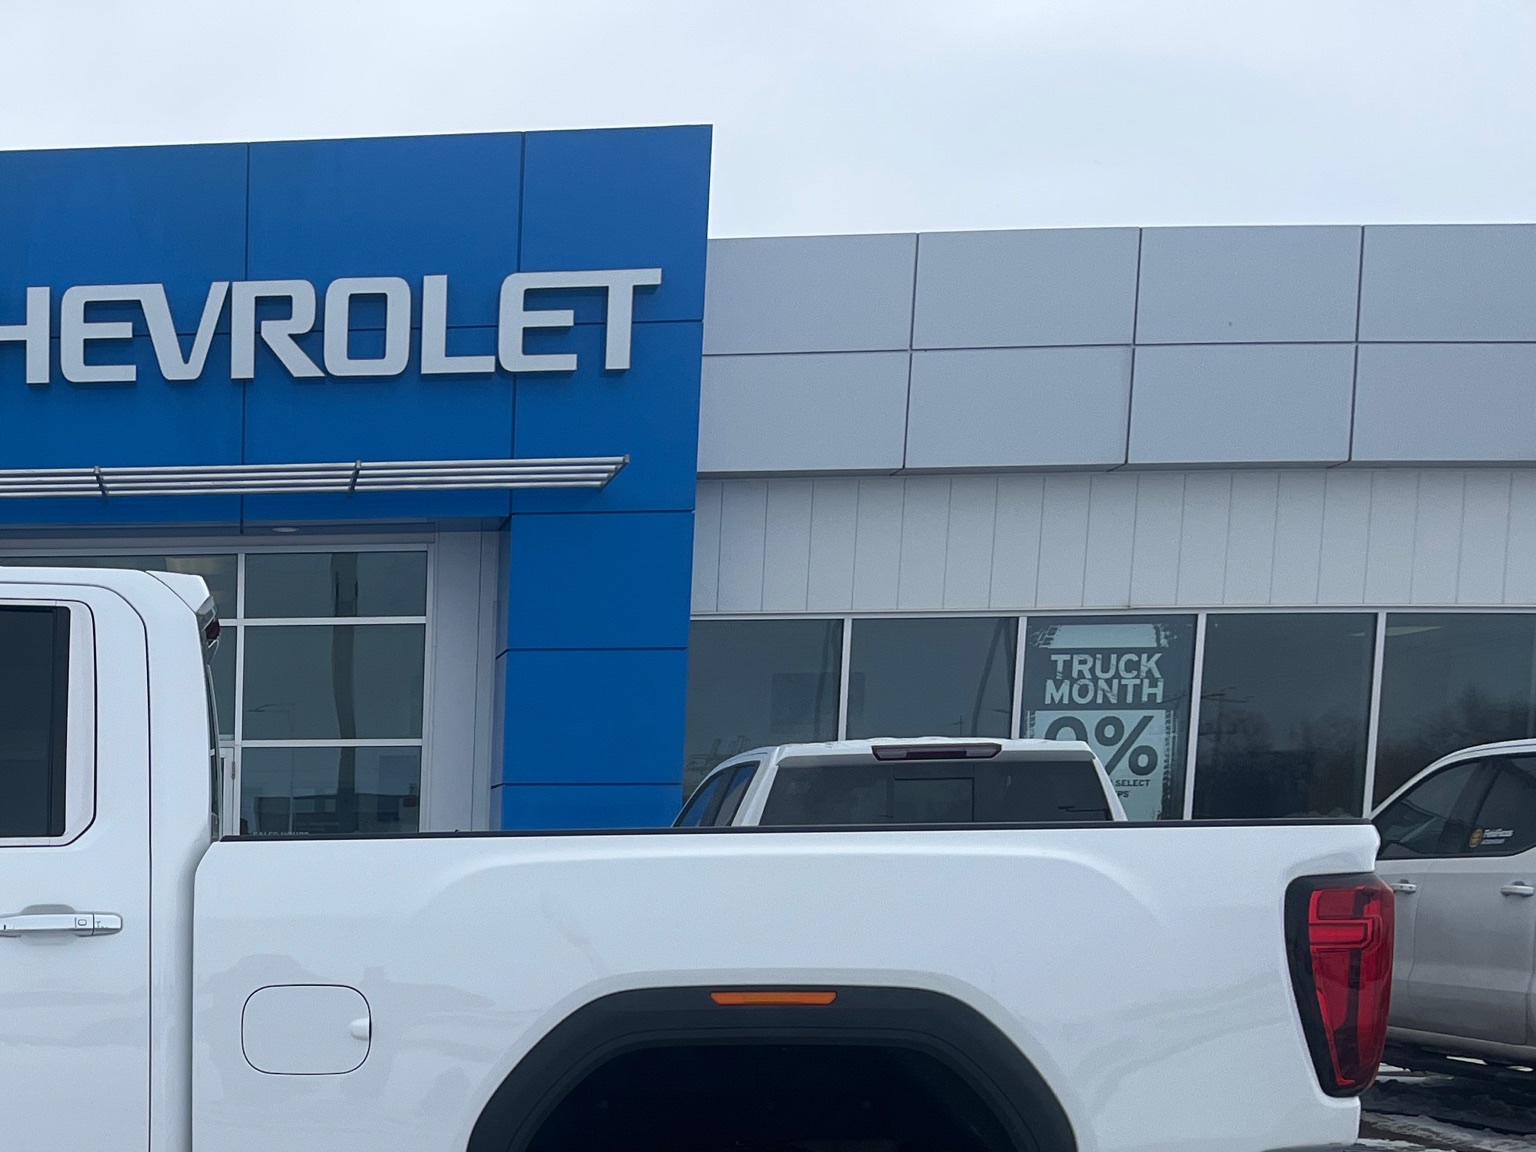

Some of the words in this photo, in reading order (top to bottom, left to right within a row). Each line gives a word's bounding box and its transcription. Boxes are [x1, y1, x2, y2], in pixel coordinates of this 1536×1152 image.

[1050, 653, 1163, 680] TRUCK
[1044, 678, 1164, 705] MONTH
[1114, 779, 1151, 787] SELECT
